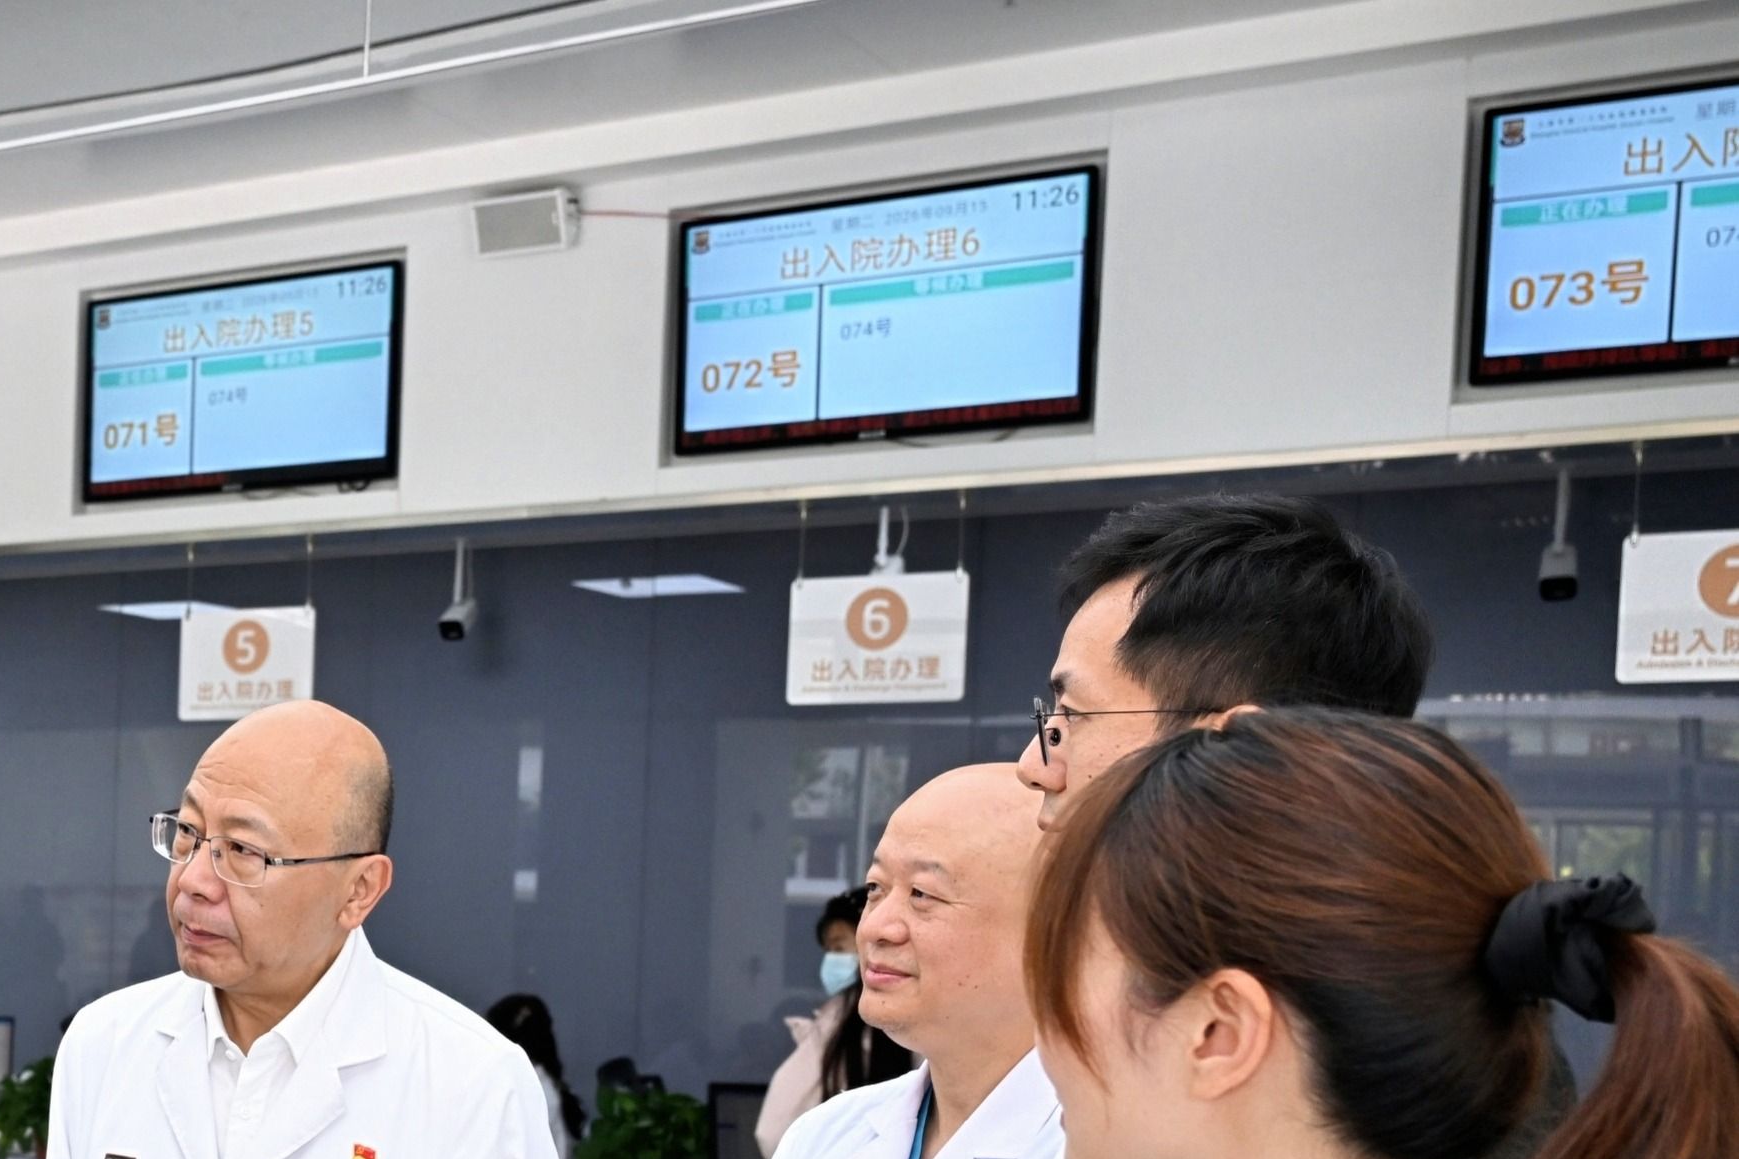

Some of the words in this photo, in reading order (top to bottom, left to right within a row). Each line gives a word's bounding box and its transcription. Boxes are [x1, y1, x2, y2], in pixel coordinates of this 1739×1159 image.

[1011, 183, 1080, 212] 11:26
[780, 227, 981, 281] 出入院办理6
[1706, 227, 1739, 248] 07
[337, 276, 388, 297] 11:26
[1509, 259, 1649, 311] 073号
[163, 311, 315, 353] 出入院办理5
[840, 317, 892, 341] 074号
[701, 349, 801, 393] 072号
[103, 413, 179, 450] 071号
[863, 598, 891, 640] 6
[235, 630, 256, 666] 5
[812, 655, 940, 682] 出入院办理
